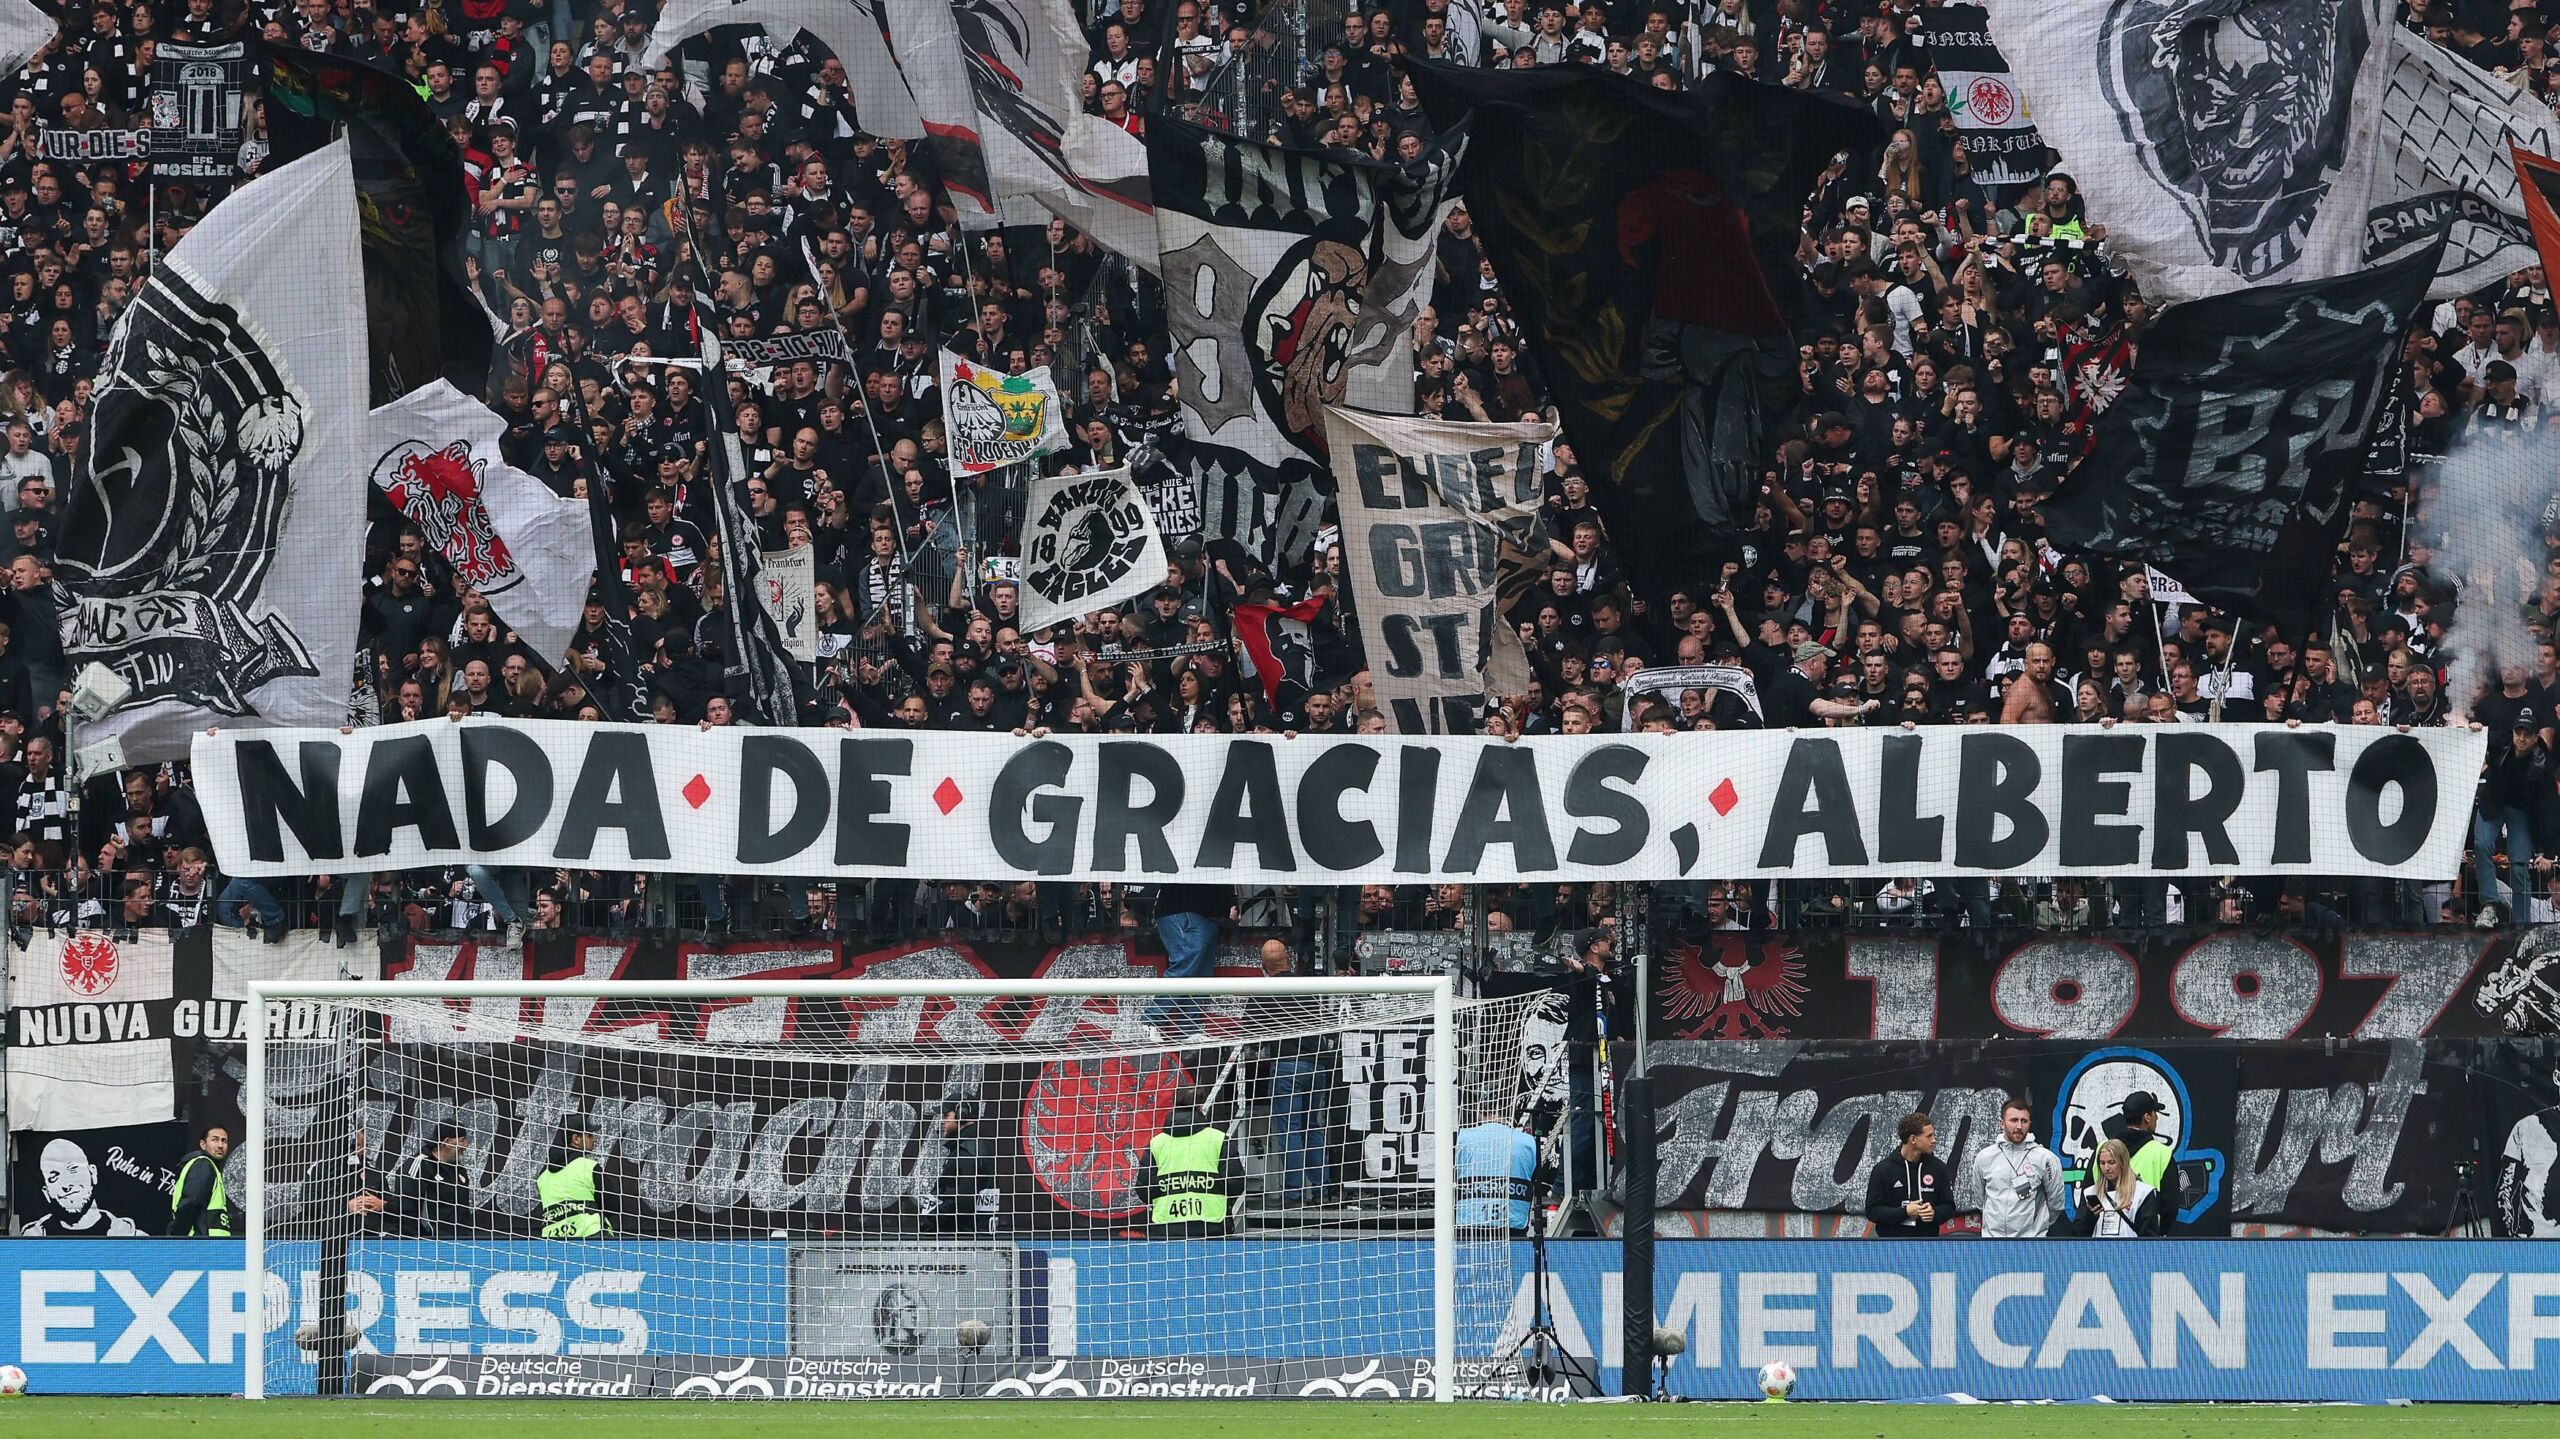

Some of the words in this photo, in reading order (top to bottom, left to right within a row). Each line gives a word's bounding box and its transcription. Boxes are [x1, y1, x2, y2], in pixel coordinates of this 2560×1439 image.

[189, 67, 217, 78] 2018
[88, 130, 126, 160] DIE
[1163, 478, 1182, 488] WIE
[1109, 502, 1144, 538] 99
[1030, 534, 1057, 566] 18
[768, 557, 806, 569] Frankfurt
[1027, 535, 1148, 606] EAGLES
[235, 725, 671, 862] NADA
[736, 735, 914, 866] DE
[989, 740, 1699, 876] GRACIAS,
[1757, 731, 2438, 870] ALBERTO
[1845, 931, 2498, 1040] 1997
[19, 1002, 150, 1047] NUOVA
[105, 1145, 140, 1178] Ruhe
[138, 1166, 155, 1185] in
[1158, 1174, 1215, 1193] STEWARD
[1169, 1197, 1203, 1218] 4610
[1494, 1271, 2246, 1371] AMERICAN
[480, 1357, 582, 1376] Deutsche
[788, 1357, 891, 1376] Deutsche
[1101, 1358, 1205, 1376] Deutsche
[475, 1374, 632, 1396] Dienstrad
[784, 1375, 942, 1397] Dienstrad
[1098, 1376, 1256, 1397] Dienstrad
